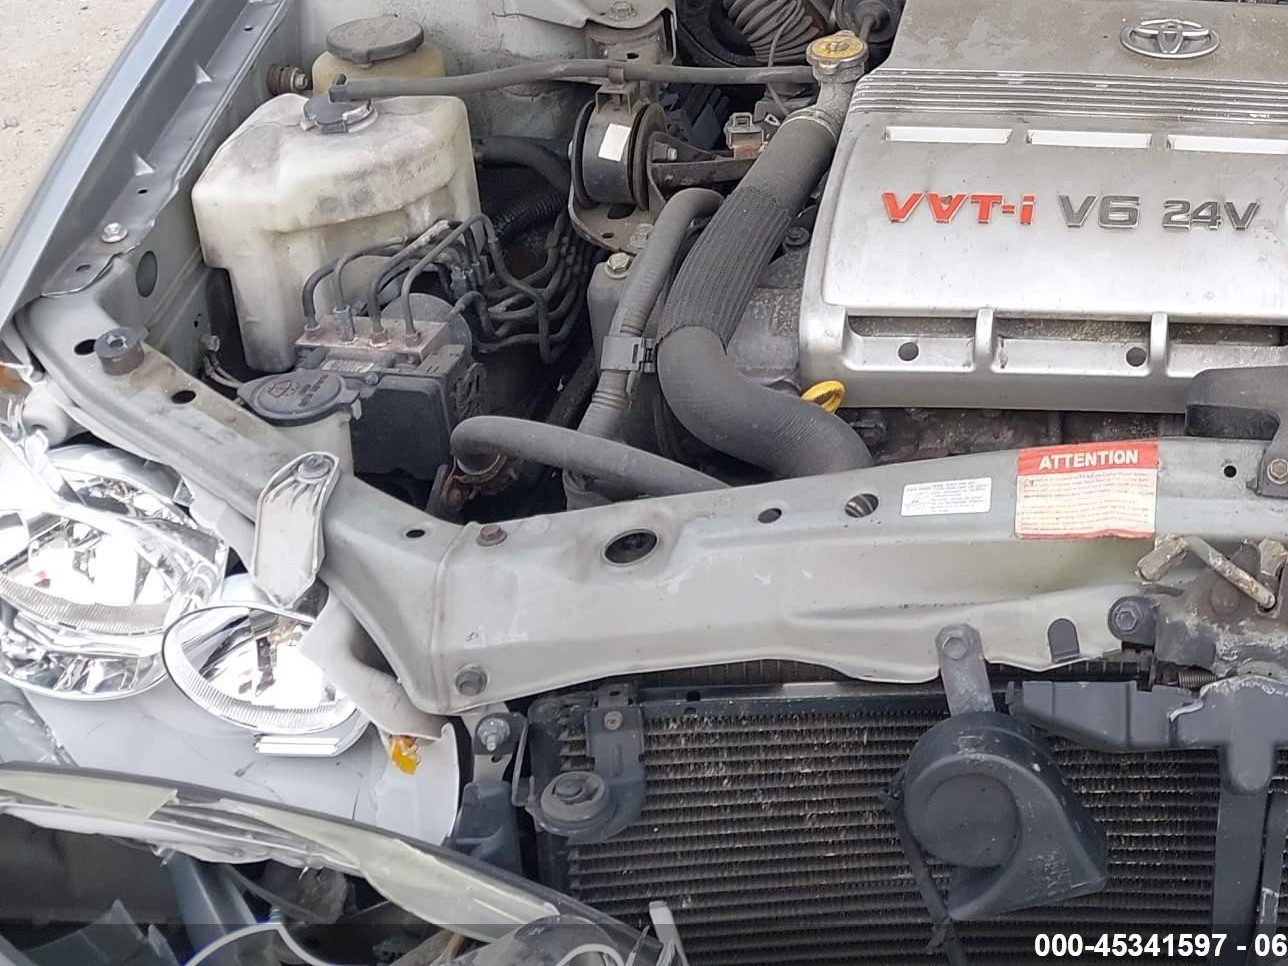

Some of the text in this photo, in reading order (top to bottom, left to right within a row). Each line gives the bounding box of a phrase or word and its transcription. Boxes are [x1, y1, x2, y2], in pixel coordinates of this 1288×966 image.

[883, 192, 1258, 230] VVT-i V6 24V
[1039, 449, 1139, 471] ATTENTION
